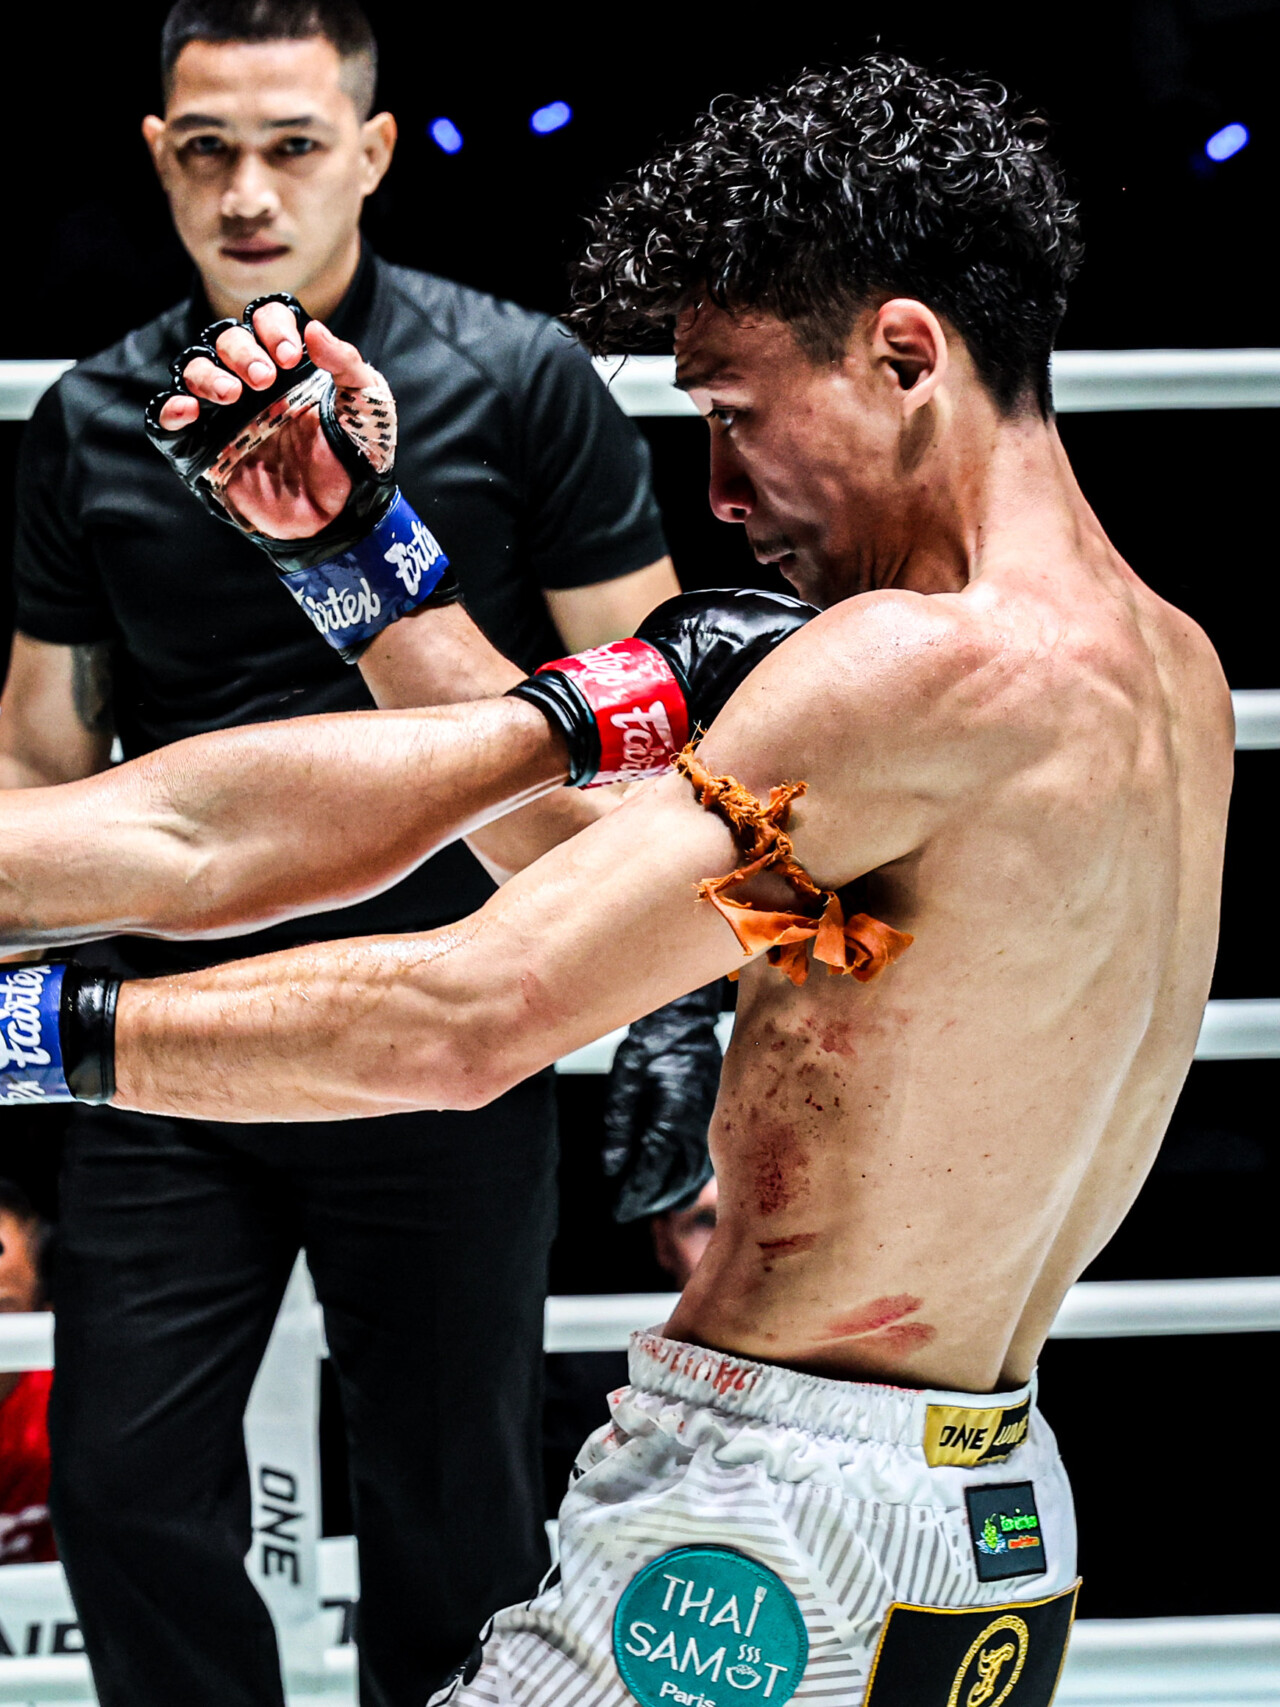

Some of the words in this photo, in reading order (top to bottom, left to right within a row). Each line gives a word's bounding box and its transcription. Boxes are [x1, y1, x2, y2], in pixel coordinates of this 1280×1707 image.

[293, 577, 381, 634] irtex
[939, 1423, 988, 1453] ONE
[254, 1466, 304, 1585] ONE
[663, 1573, 768, 1638] THAI
[659, 1681, 717, 1707] Paris
